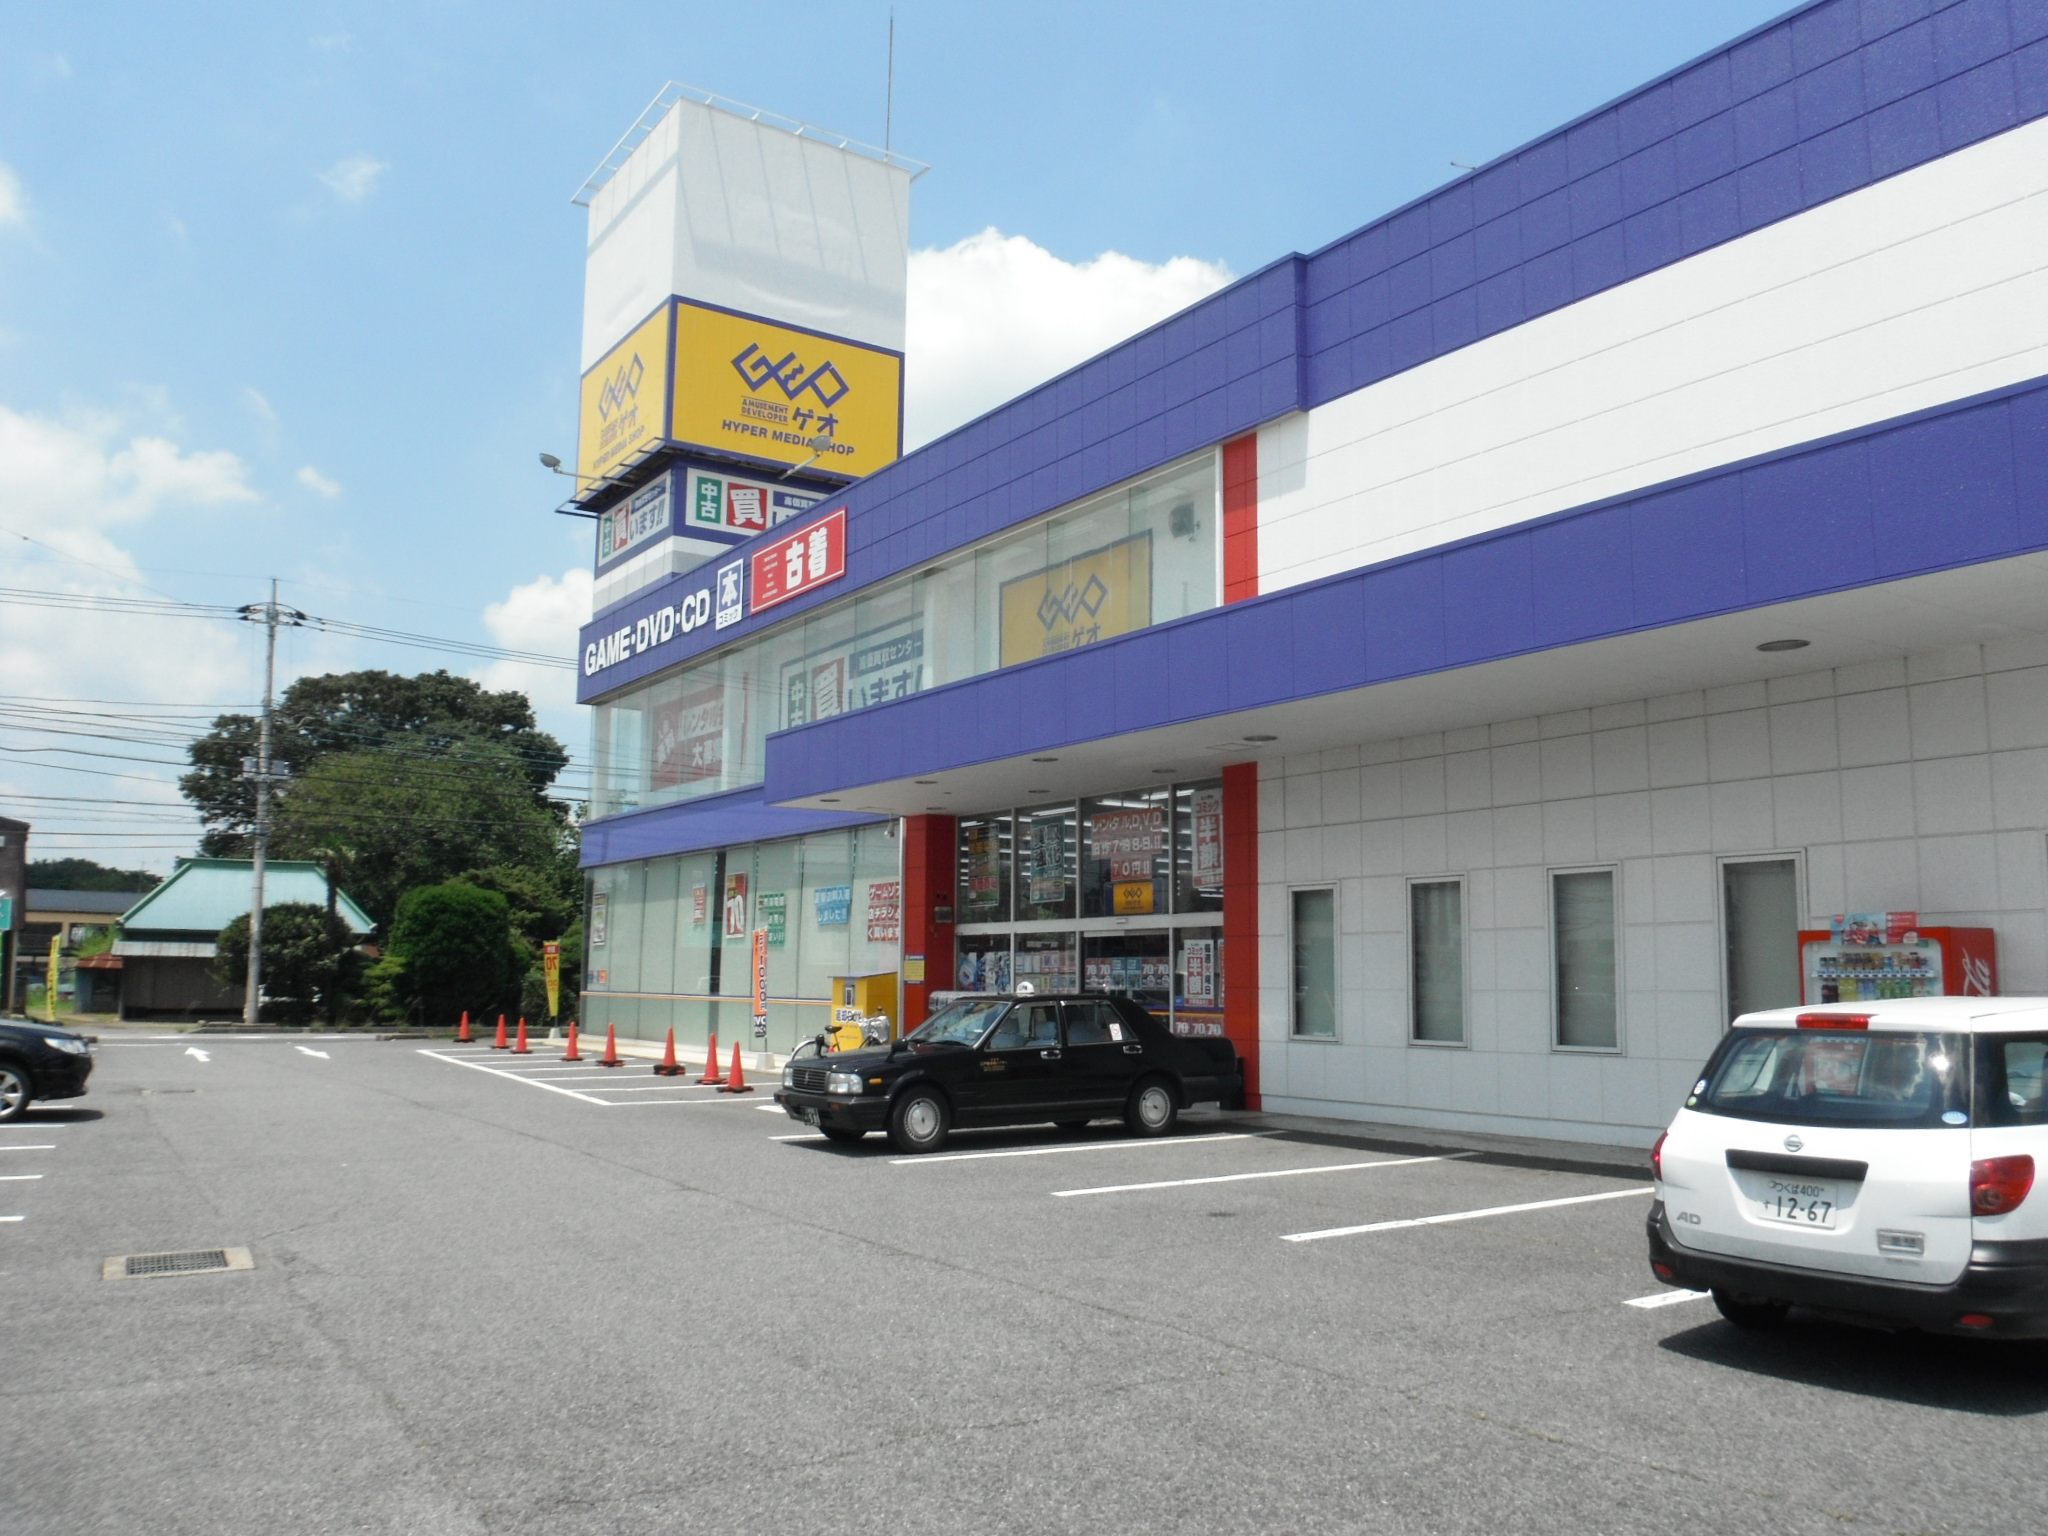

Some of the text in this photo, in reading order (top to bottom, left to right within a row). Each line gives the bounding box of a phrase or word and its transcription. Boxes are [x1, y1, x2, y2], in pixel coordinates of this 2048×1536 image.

[741, 399, 789, 414] AMUSEMENT
[741, 407, 789, 423] DEVELOPER
[722, 419, 768, 438] HYPER
[772, 430, 813, 449] MEDIA
[792, 407, 838, 437] ゲオ
[700, 482, 718, 519] 中古
[730, 488, 765, 526] 買
[785, 526, 828, 590] 古着
[721, 570, 738, 607] 本
[719, 608, 738, 626] コミック
[1676, 1211, 1701, 1225] AD
[1777, 1195, 1832, 1223] 12-67
